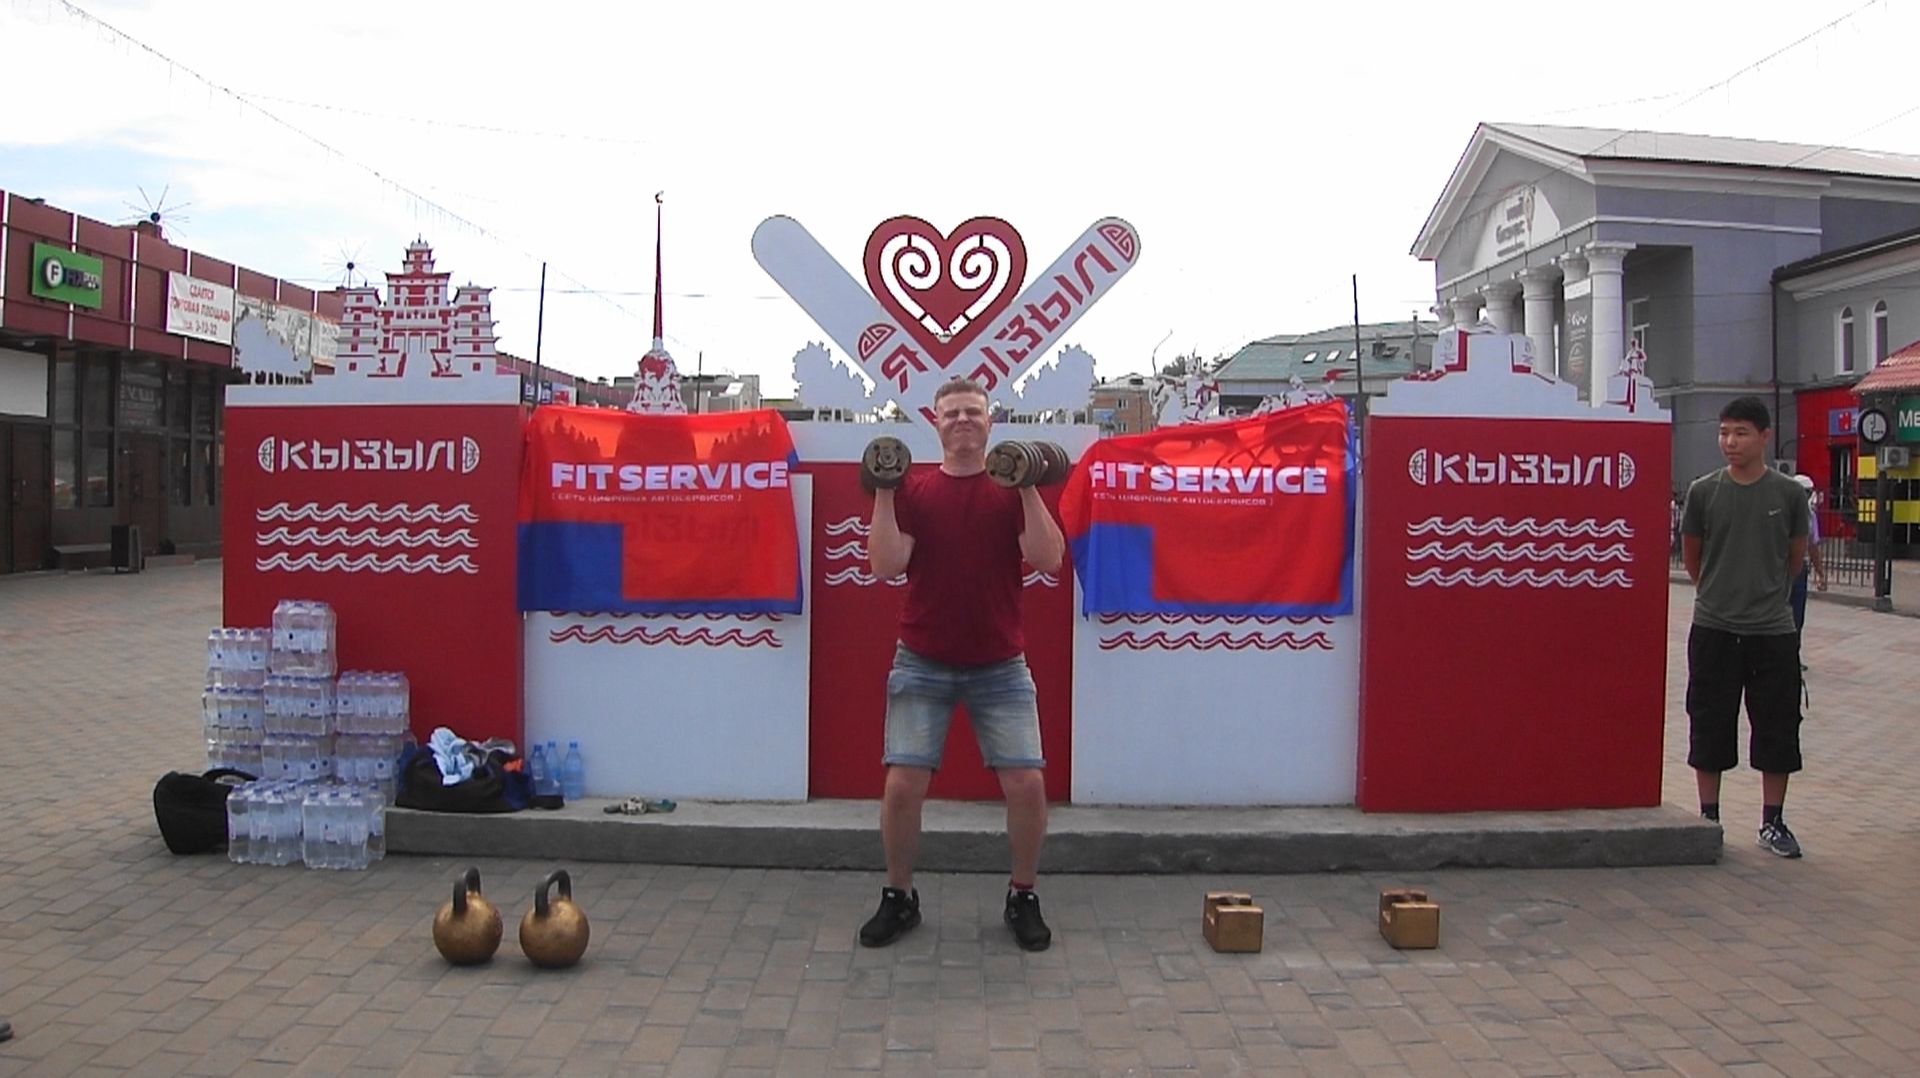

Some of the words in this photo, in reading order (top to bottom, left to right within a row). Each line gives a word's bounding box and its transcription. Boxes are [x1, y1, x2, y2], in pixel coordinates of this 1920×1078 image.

[880, 342, 929, 394] Я
[281, 439, 455, 472] КЫЗЫЛ
[1434, 452, 1612, 486] КЫЗЫЛ
[552, 462, 614, 490] FIT
[618, 460, 788, 491] SERVICE
[1089, 460, 1145, 490] FIT
[1149, 464, 1328, 493] SERVICE
